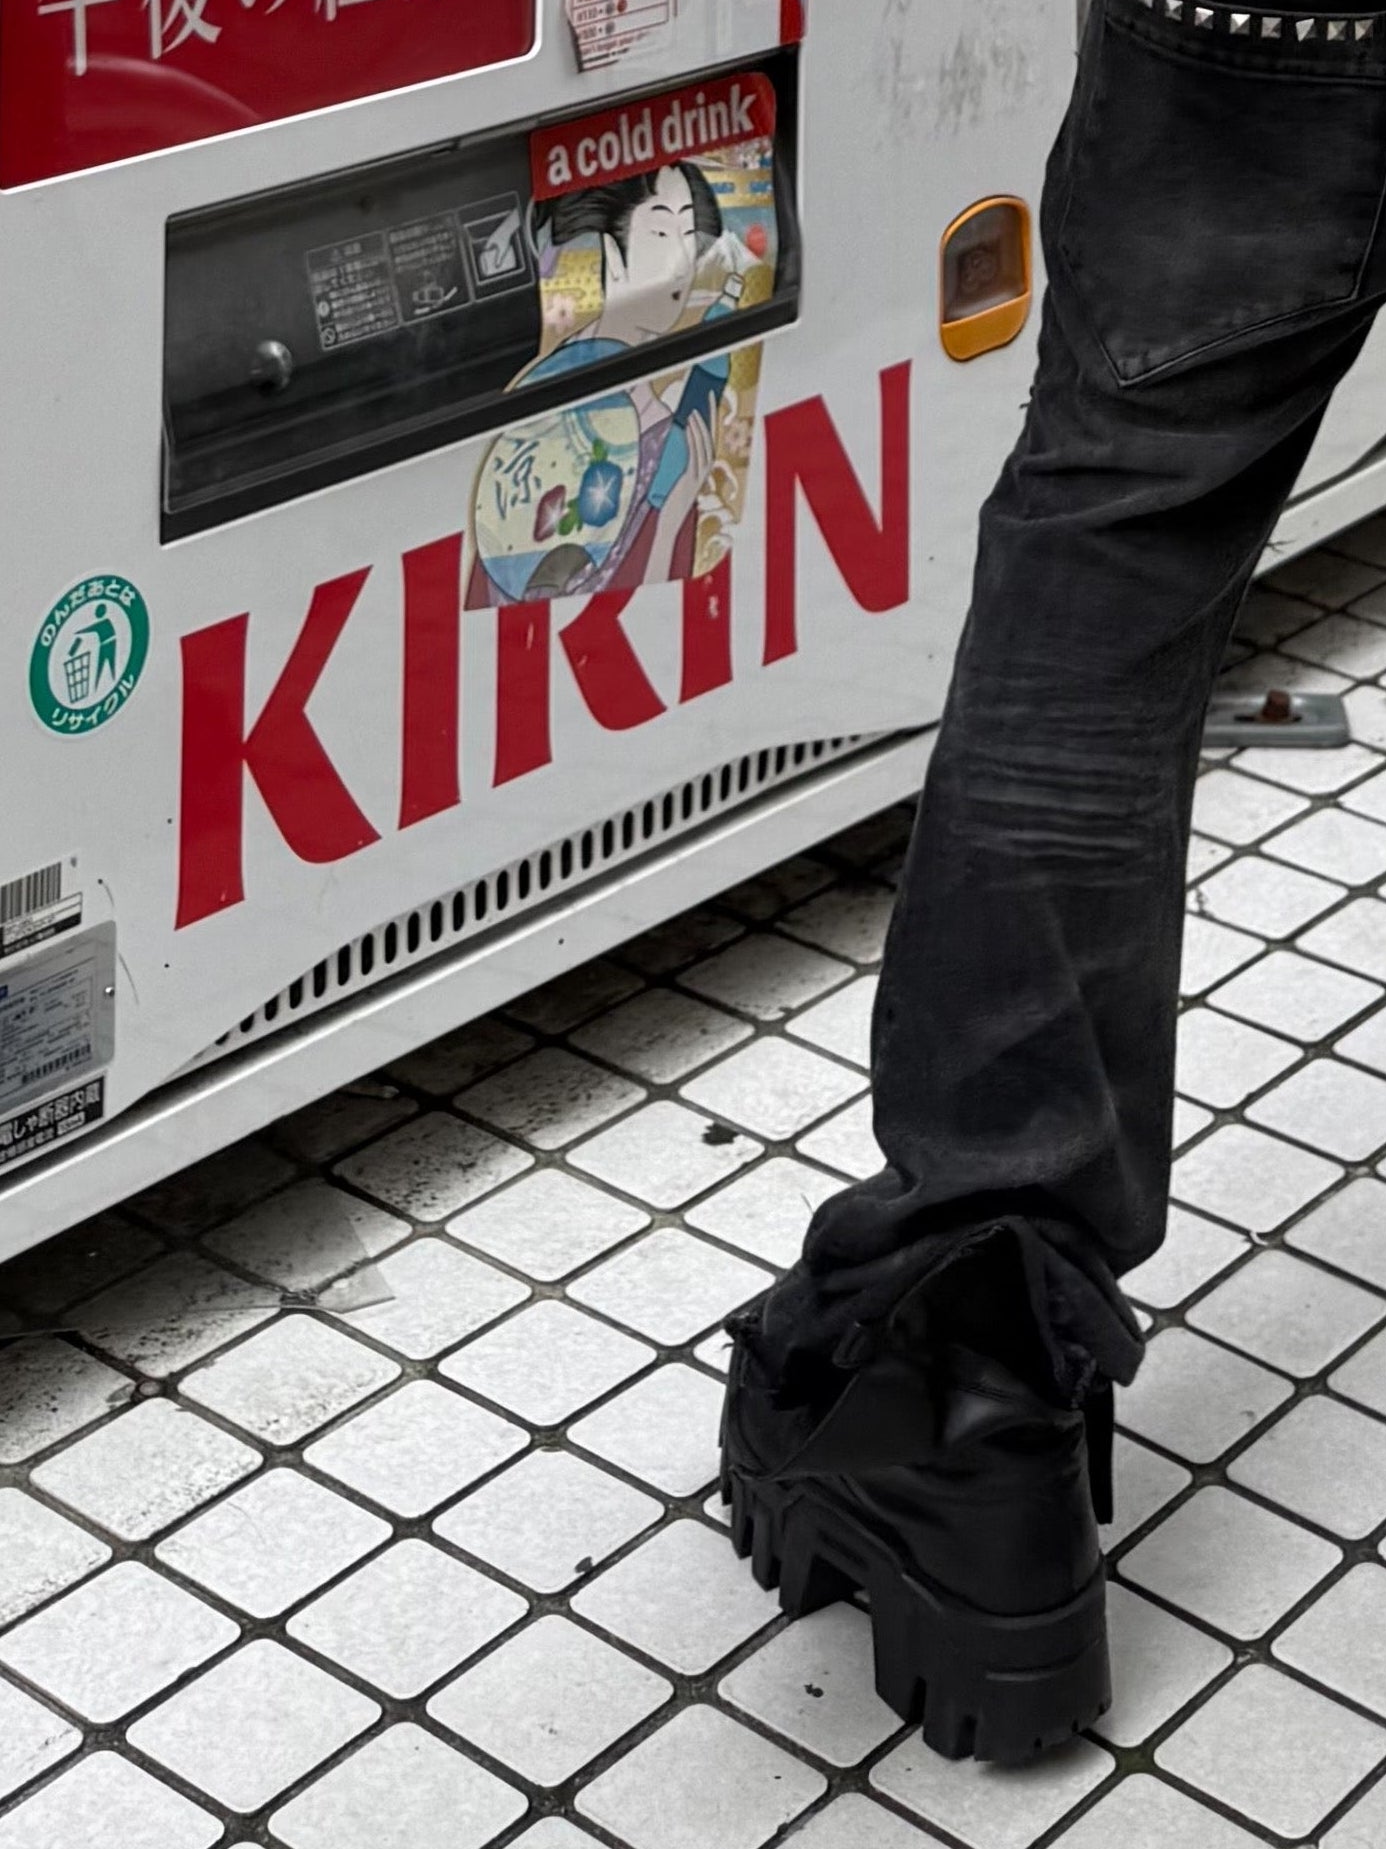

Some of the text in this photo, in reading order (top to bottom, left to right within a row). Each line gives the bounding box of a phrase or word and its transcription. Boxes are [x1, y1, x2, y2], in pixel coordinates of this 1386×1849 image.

[547, 82, 757, 187] a cold drink
[40, 579, 137, 648] のんだあとは
[51, 673, 135, 732] リサイクル
